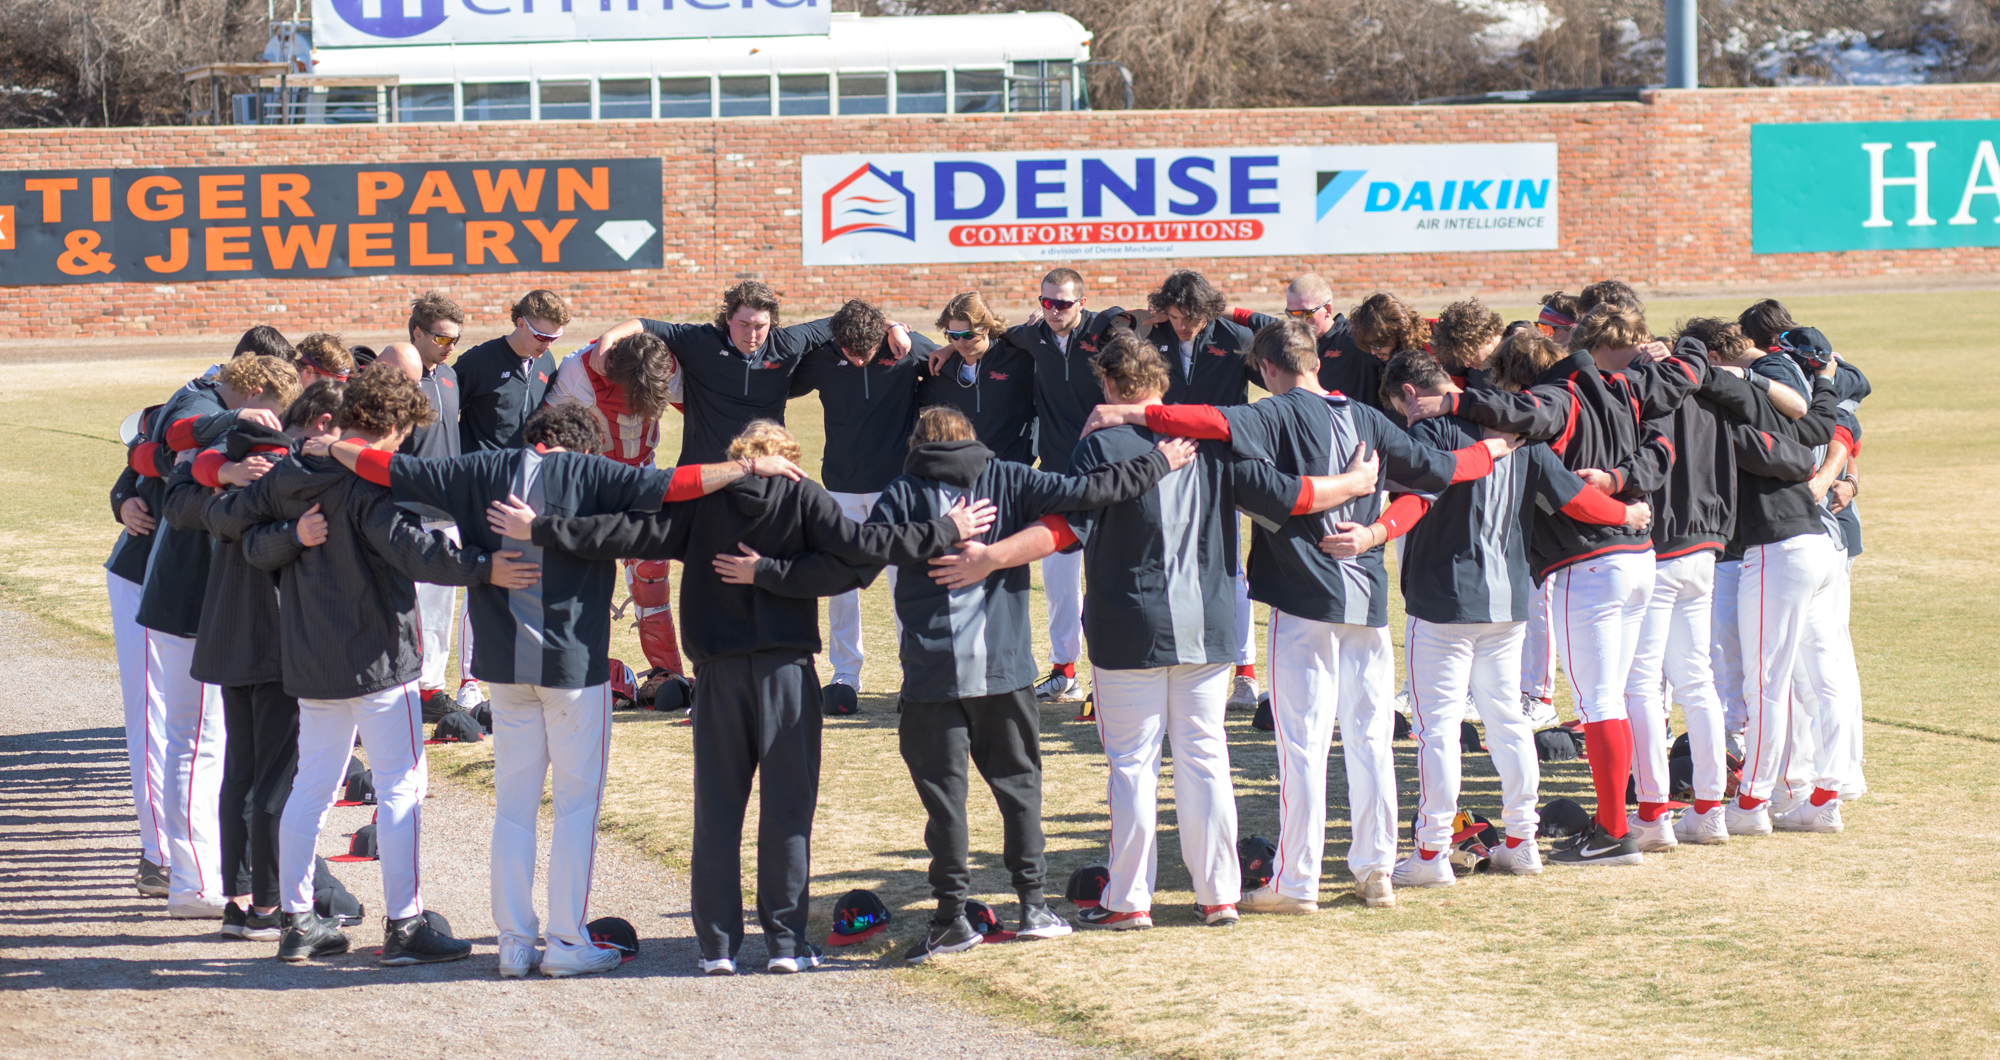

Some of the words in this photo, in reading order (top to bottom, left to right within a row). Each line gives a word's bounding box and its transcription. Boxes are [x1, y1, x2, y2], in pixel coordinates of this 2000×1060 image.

[25, 173, 315, 223] TIGER
[357, 167, 610, 216] PAWN
[934, 155, 1281, 221] DENSE
[1364, 179, 1551, 212] DAIKIN
[960, 225, 1093, 245] COMFORT
[1100, 221, 1254, 242] SOLUTIONS
[1416, 218, 1440, 230] AIR
[1445, 216, 1545, 230] INTELLIGENCE
[56, 229, 117, 276] &
[144, 218, 579, 274] JEWELRY
[1048, 246, 1082, 255] division
[1084, 245, 1093, 254] of
[1096, 245, 1121, 253] Dense
[1124, 244, 1174, 252] Mechanical
